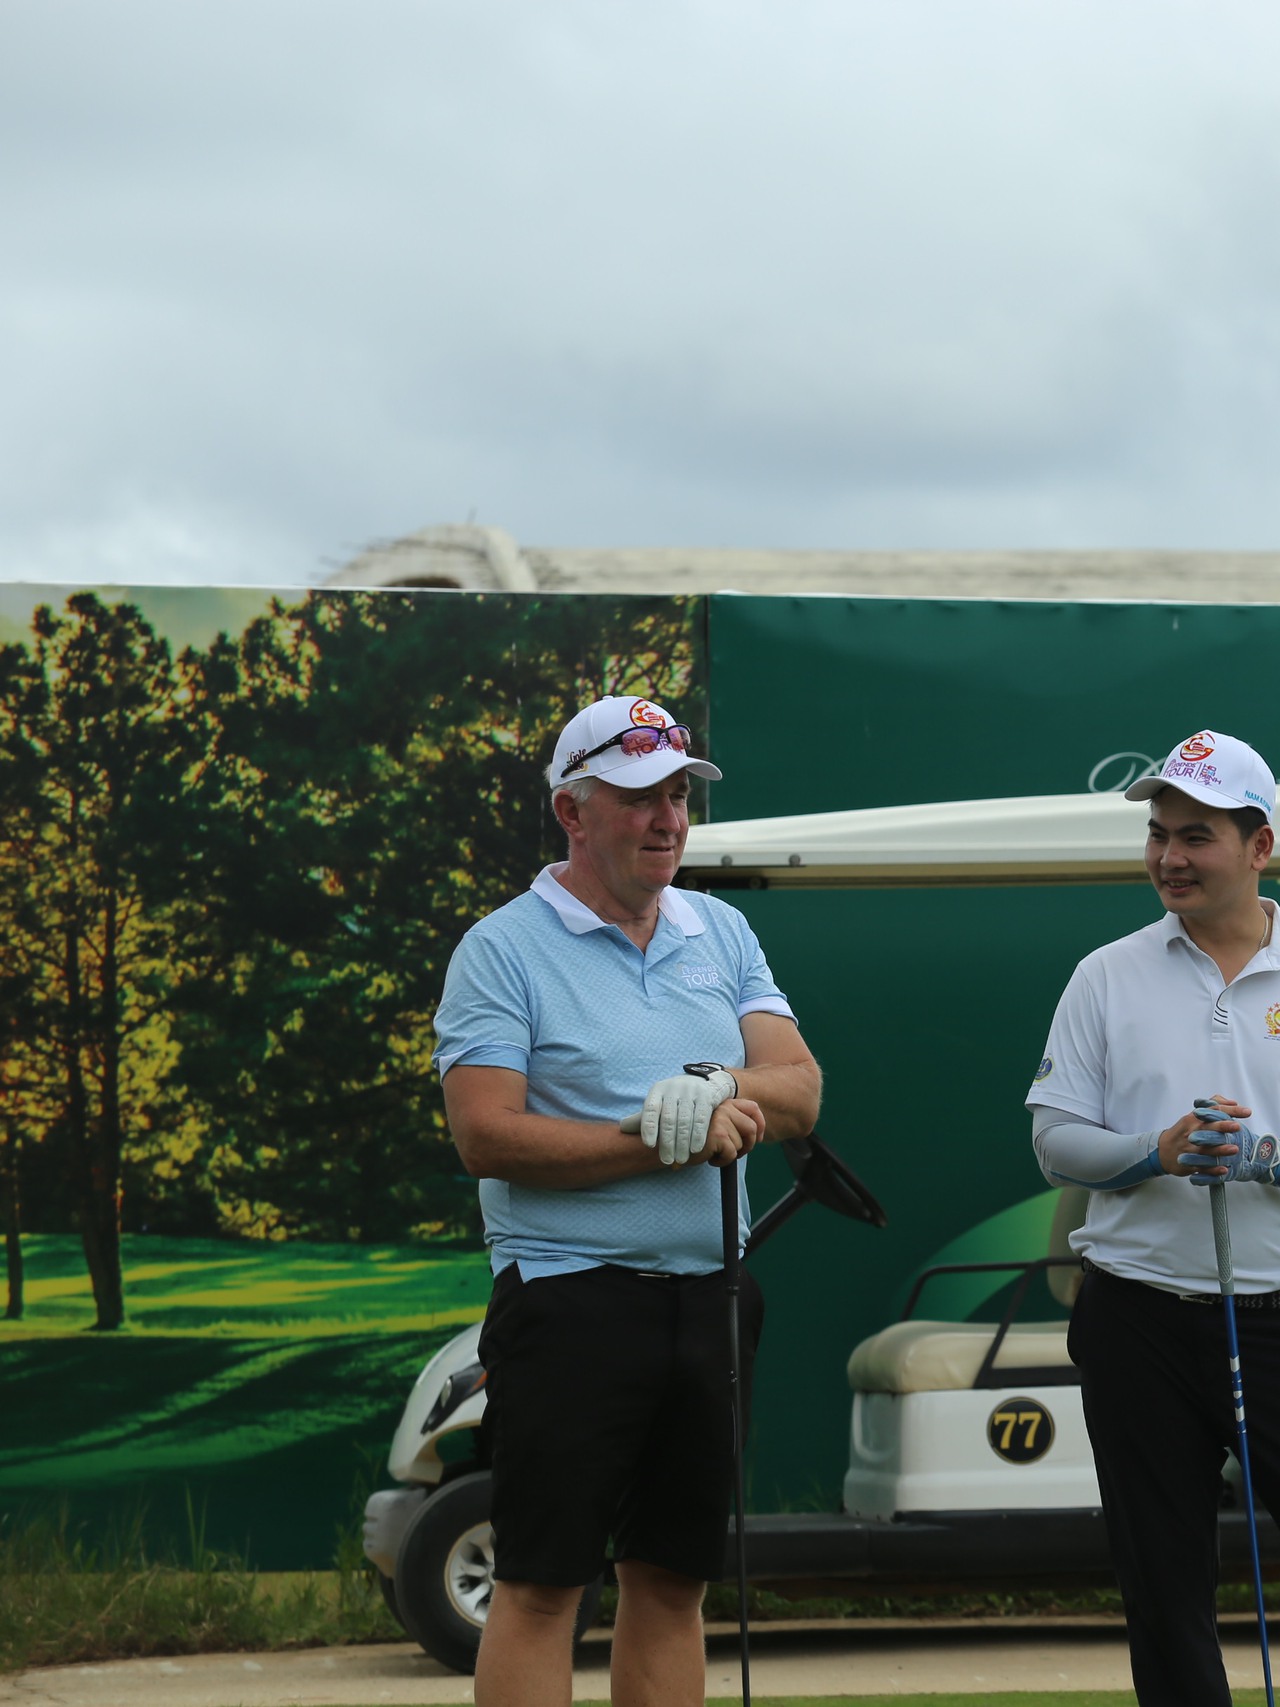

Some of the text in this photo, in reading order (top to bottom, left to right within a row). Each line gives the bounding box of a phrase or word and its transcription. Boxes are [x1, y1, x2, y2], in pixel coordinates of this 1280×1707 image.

[682, 965, 717, 975] LEGENDS
[682, 972, 721, 989] TOUR
[993, 1411, 1042, 1450] 77
